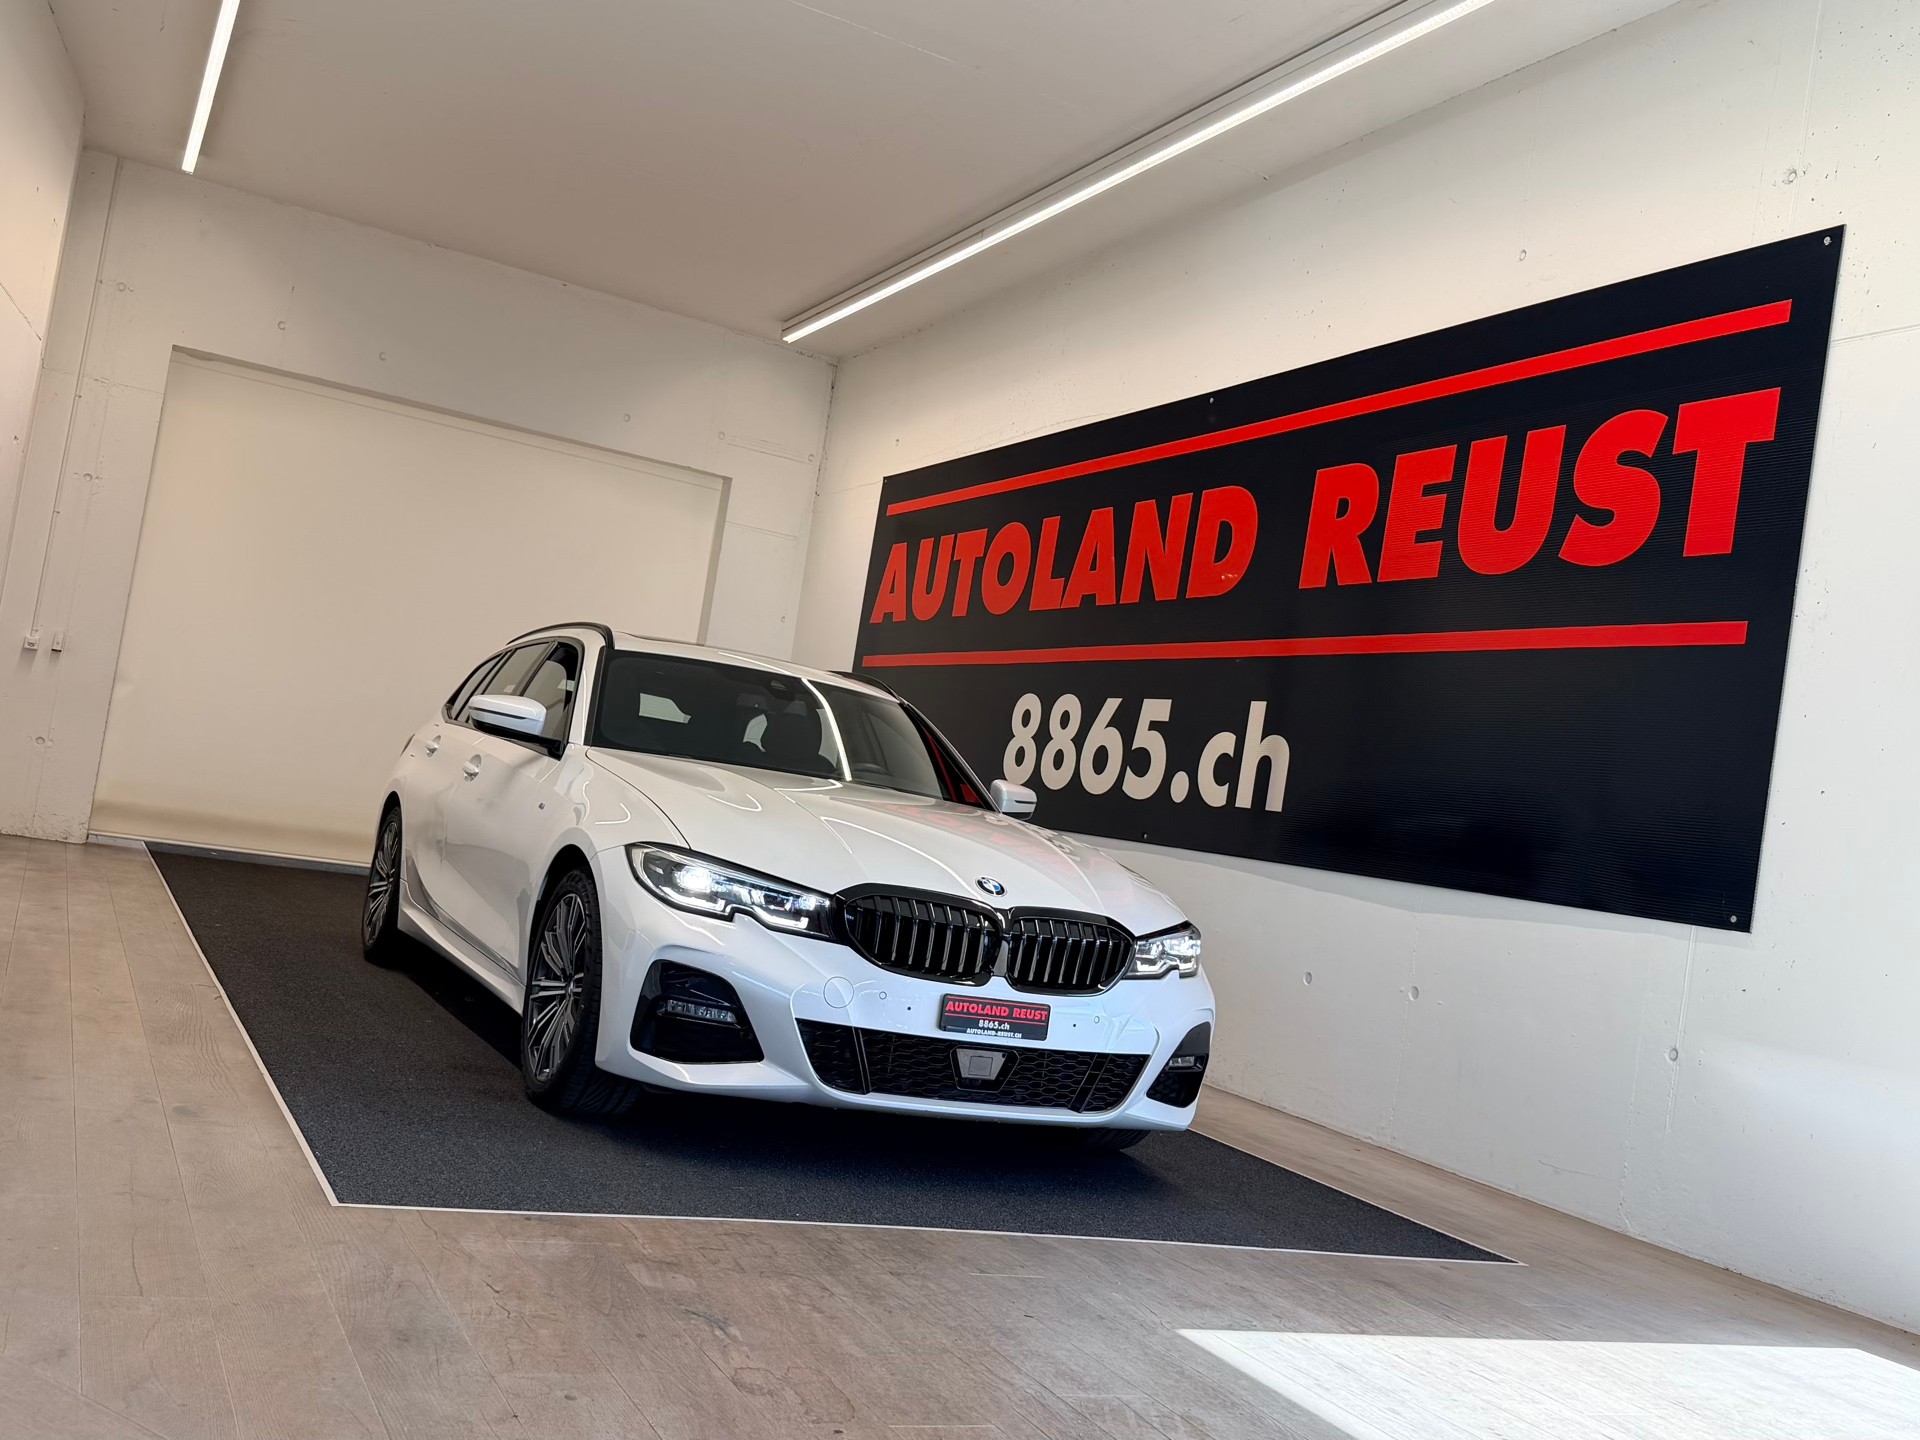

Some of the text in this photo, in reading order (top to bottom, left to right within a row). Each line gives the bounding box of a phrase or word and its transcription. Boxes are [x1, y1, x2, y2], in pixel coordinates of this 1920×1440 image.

[869, 388, 1781, 624] AUTOLAND REUST
[1003, 693, 1290, 812] 8865.ch
[946, 1001, 1048, 1020] AUTOLAND REUST
[978, 1019, 1010, 1030] 8865.ch
